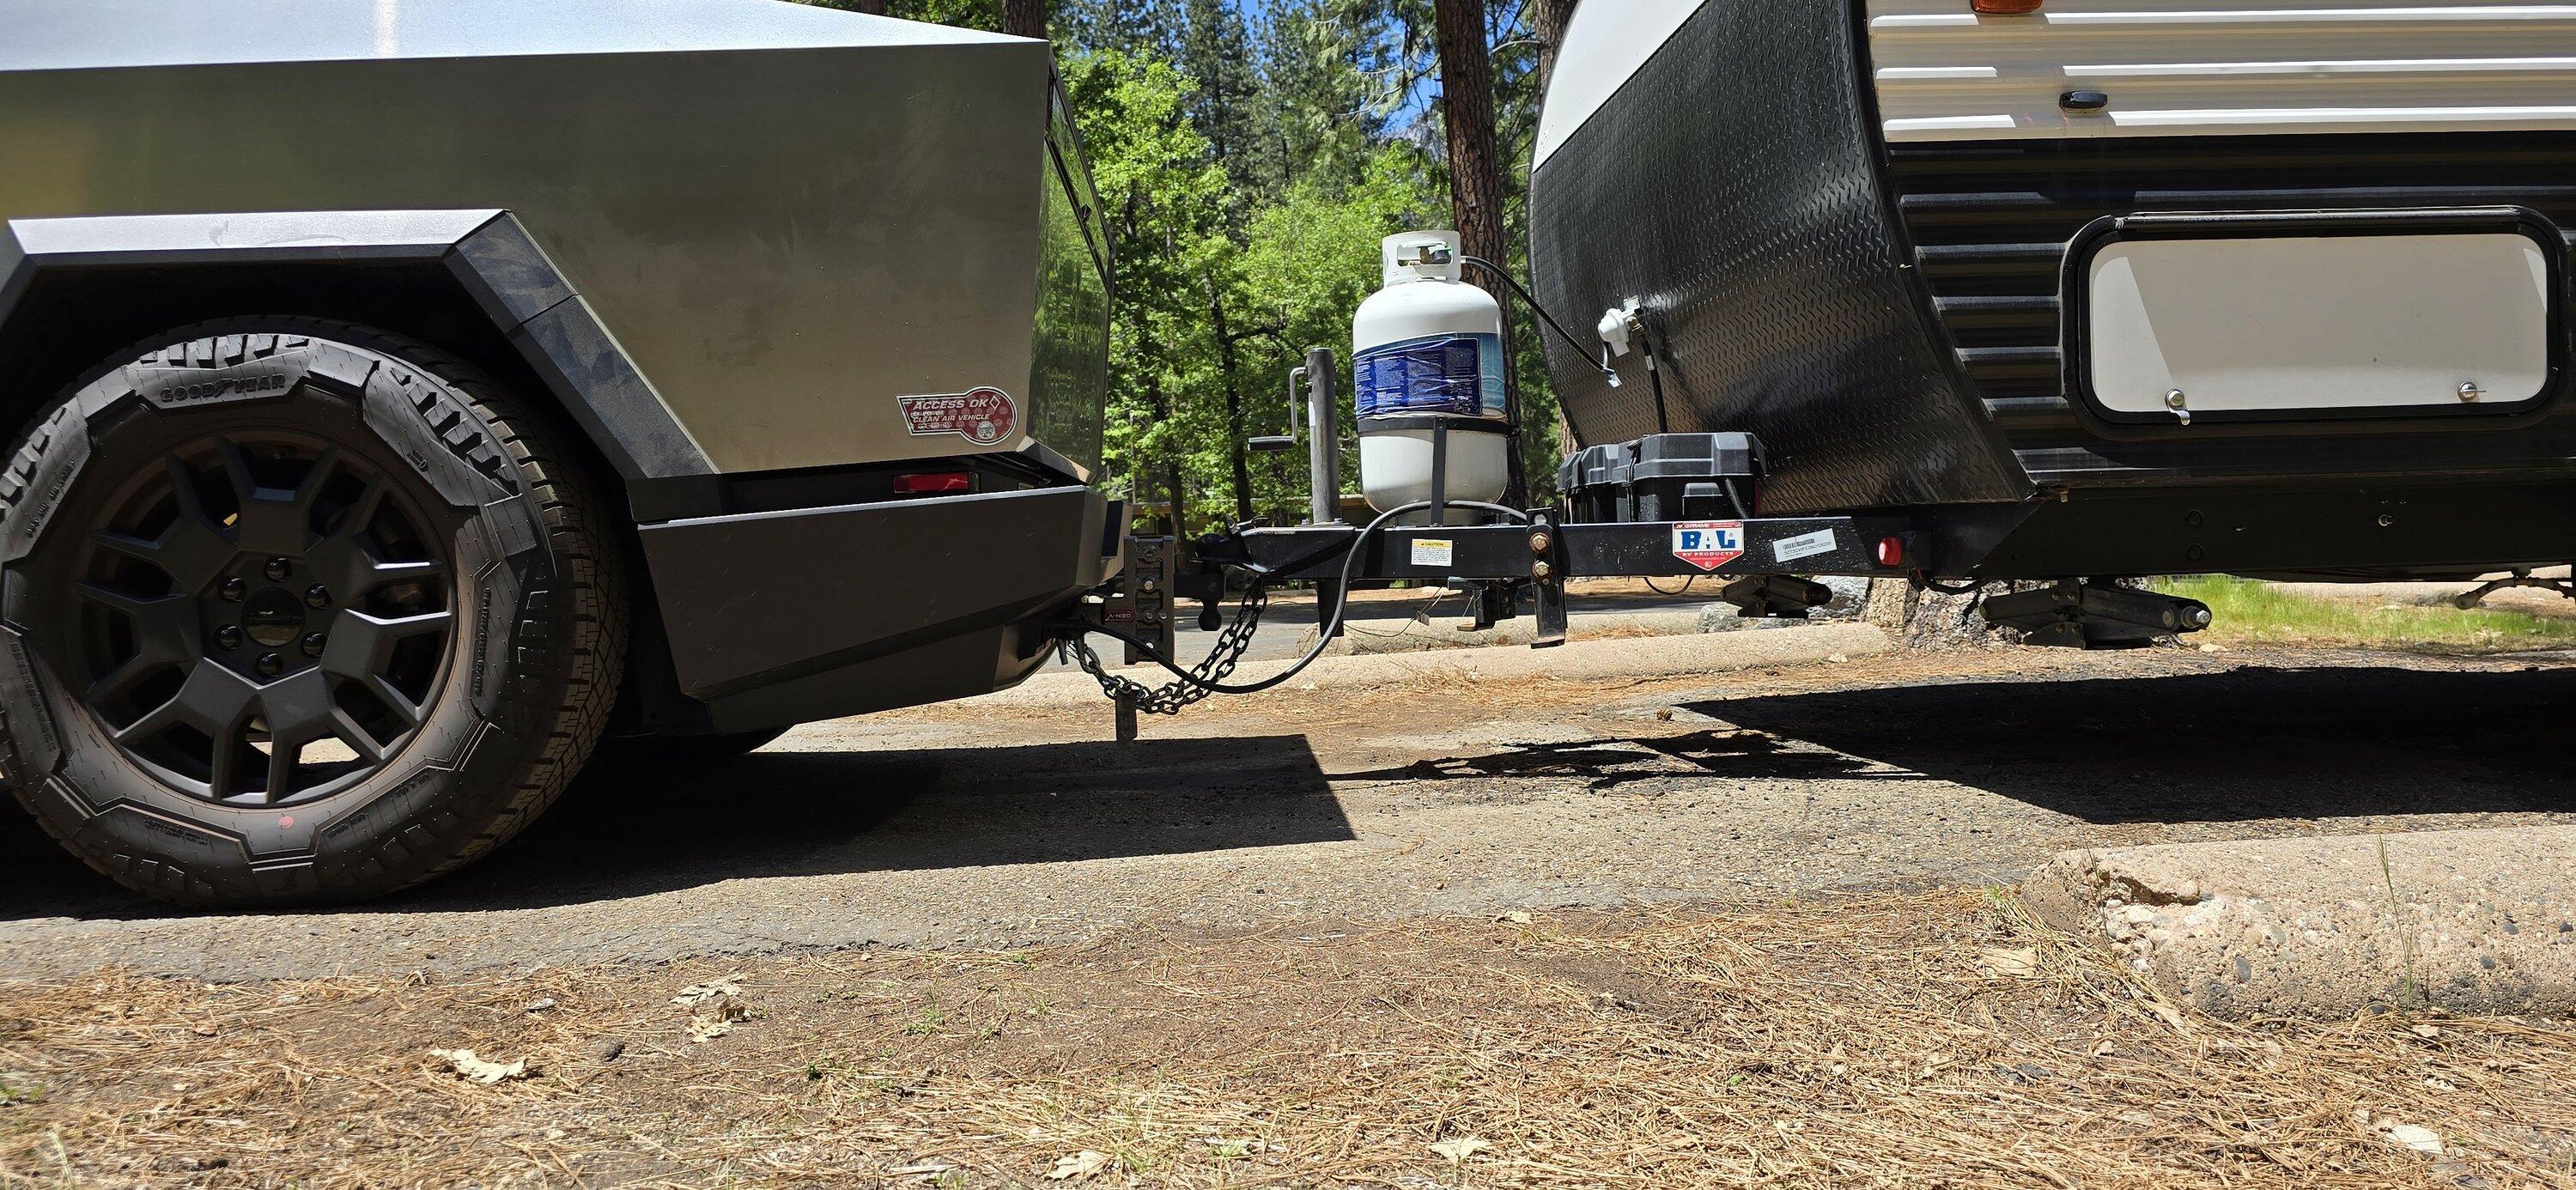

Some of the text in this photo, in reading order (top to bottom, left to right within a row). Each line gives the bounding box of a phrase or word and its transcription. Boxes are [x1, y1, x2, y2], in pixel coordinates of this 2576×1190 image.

[160, 373, 286, 403] GOODYEAR
[913, 399, 988, 410] ACCESS OK
[1680, 530, 1736, 550] BAL
